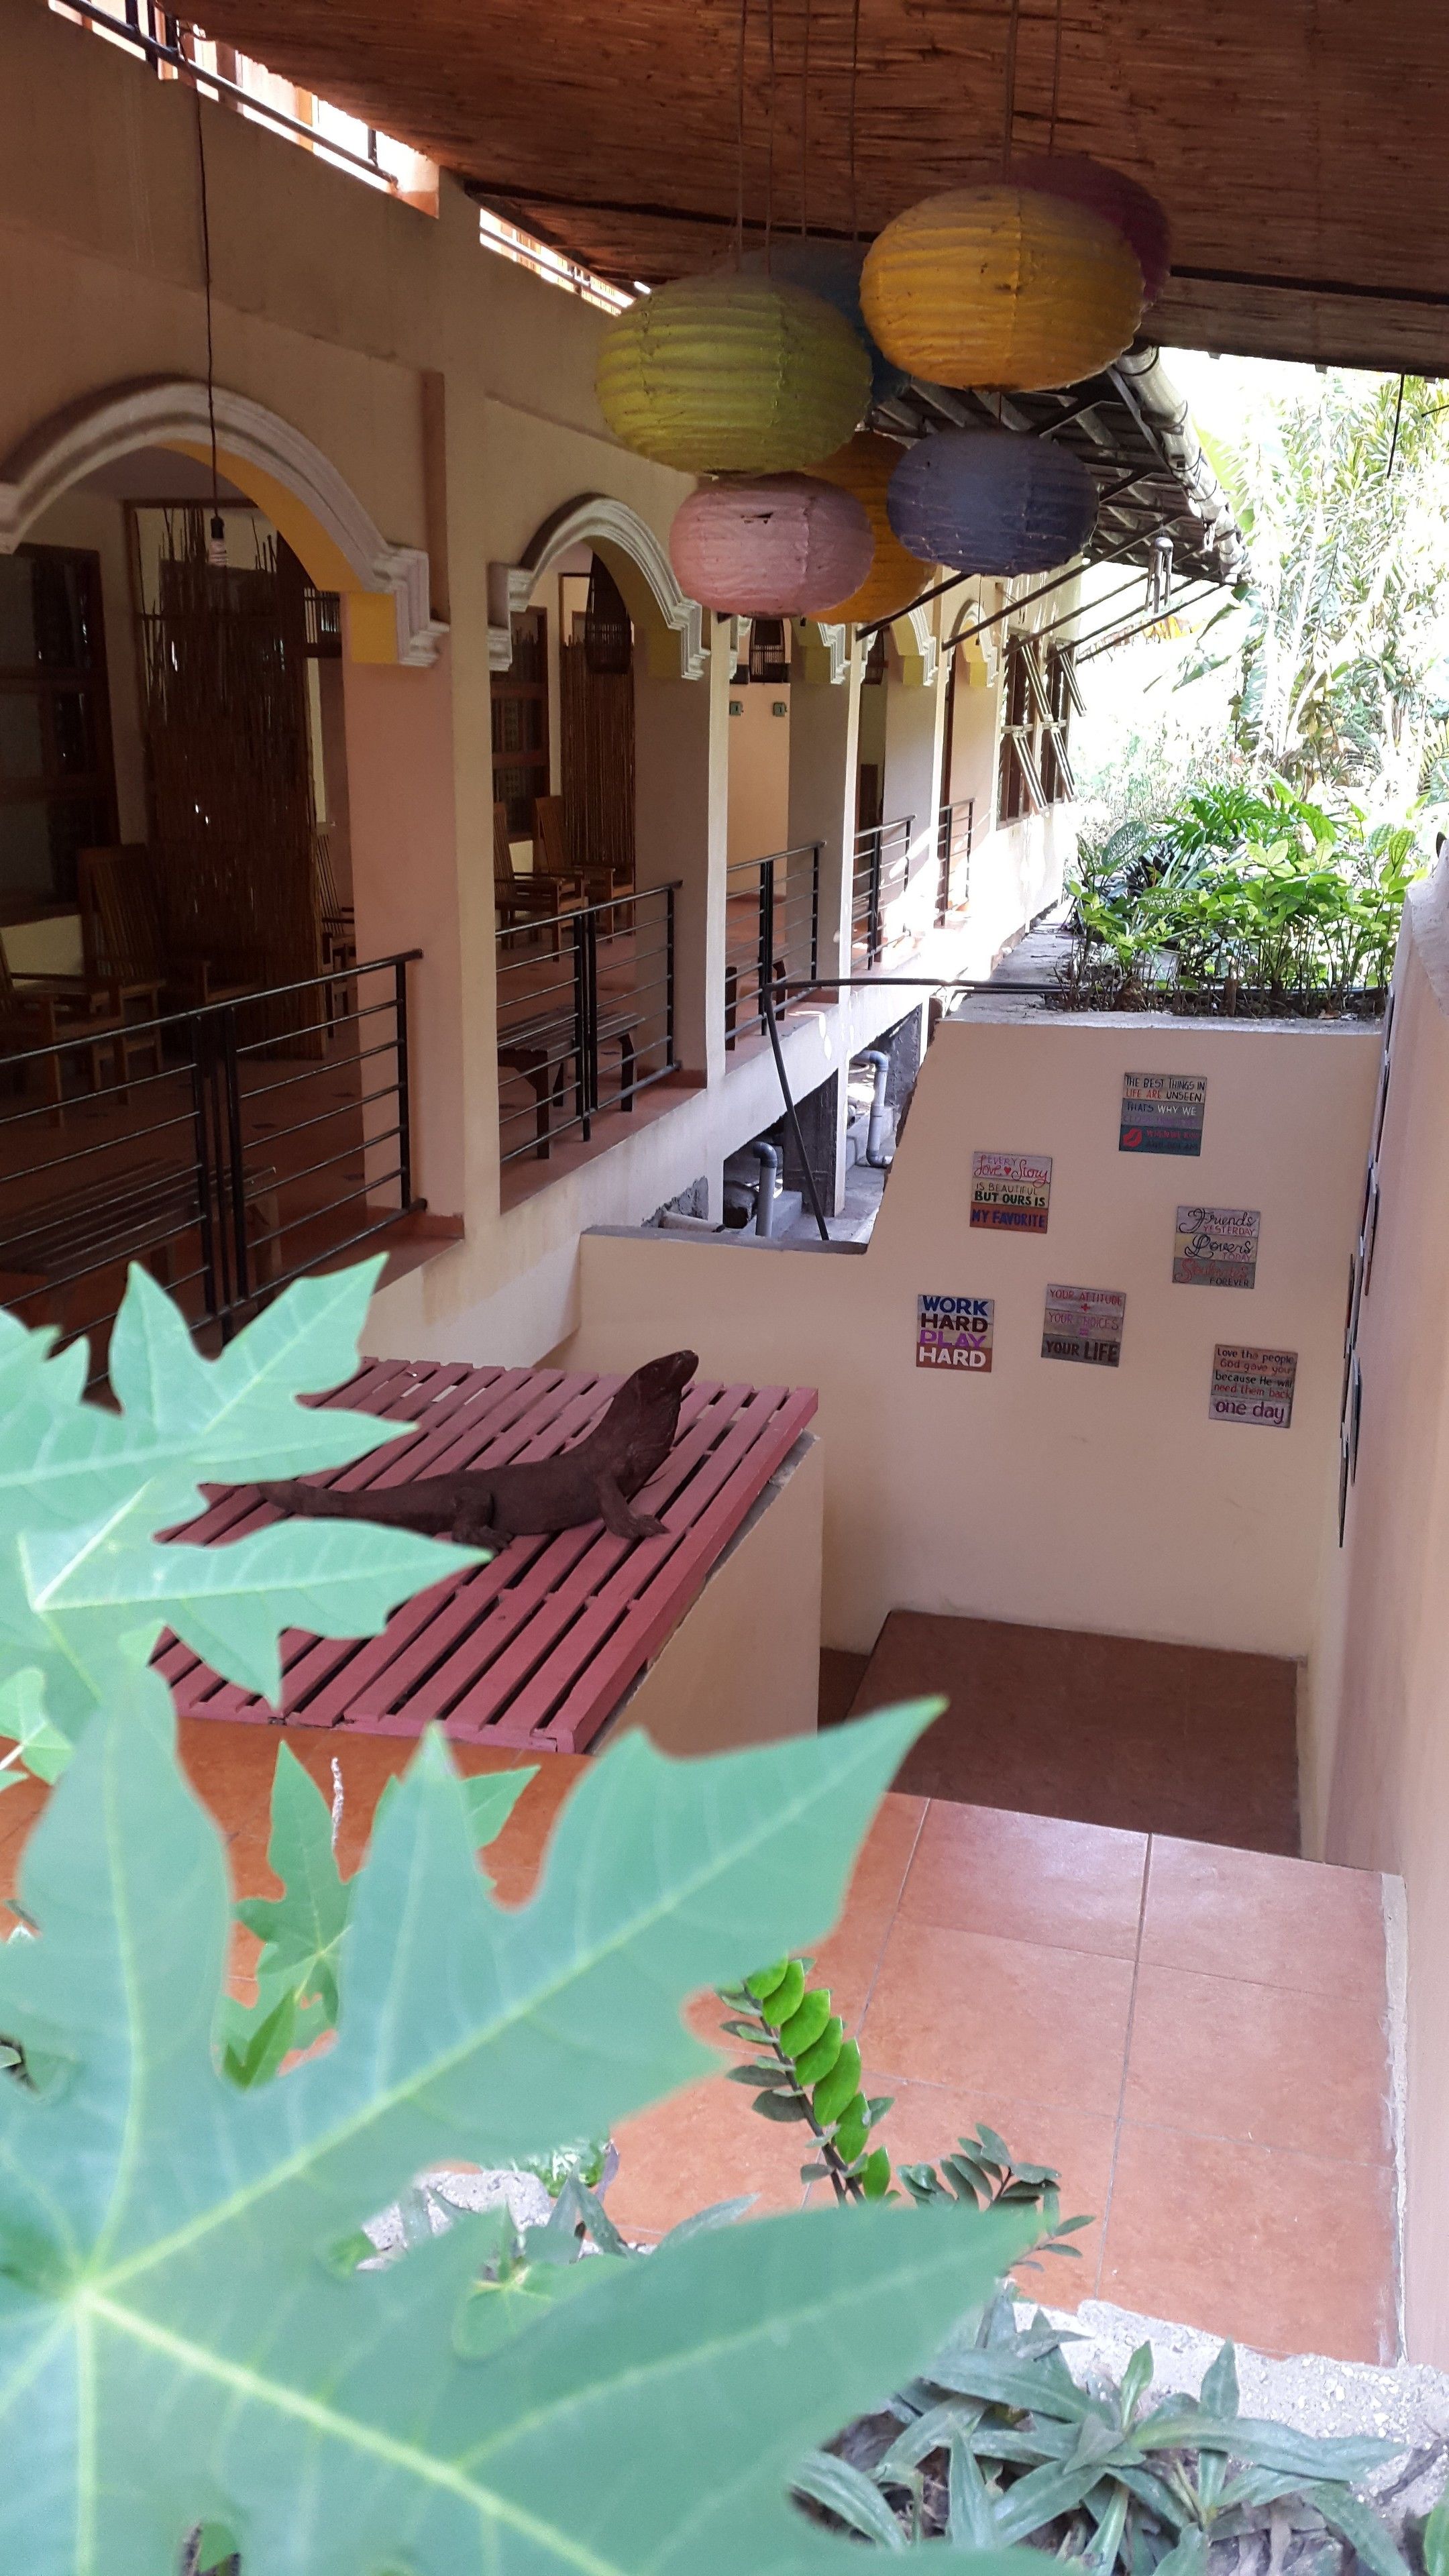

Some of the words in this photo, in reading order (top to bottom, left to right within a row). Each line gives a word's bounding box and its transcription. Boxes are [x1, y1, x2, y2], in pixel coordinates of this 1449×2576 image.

[1126, 1077, 1138, 1087] THE
[1143, 1078, 1164, 1088] BEST
[1169, 1077, 1195, 1090] THINGS
[1197, 1081, 1205, 1091] IN
[1126, 1088, 1140, 1098] LIFE
[1146, 1089, 1161, 1099] ARE
[1166, 1091, 1202, 1102] UNSEEN
[1157, 1104, 1179, 1114] WHY
[1182, 1106, 1196, 1116] WE
[987, 1157, 1018, 1166] EVERY
[974, 1155, 1002, 1177] Love
[1012, 1159, 1049, 1188] Story
[977, 1182, 985, 1191] IS
[989, 1183, 1038, 1195] BEAUTIFUL
[975, 1191, 999, 1202] BUT
[1002, 1194, 1032, 1205] OURS
[1034, 1197, 1045, 1207] IS
[972, 1209, 989, 1222] MY
[992, 1210, 1045, 1228] FAVORITE
[1179, 1208, 1256, 1233] Friends
[1203, 1225, 1255, 1235] YESTERDAY
[1185, 1234, 1253, 1258] Lovers
[1223, 1252, 1252, 1261] TODAY
[1210, 1277, 1249, 1286] FOREVER
[1050, 1289, 1074, 1300] YOUR
[1079, 1291, 1122, 1305] ATTITUDE
[922, 1295, 988, 1316] WORK
[921, 1313, 988, 1333] HARD
[1049, 1312, 1073, 1324] YOUR
[1079, 1316, 1119, 1330] HOICES
[920, 1330, 987, 1350] PLAY
[919, 1346, 986, 1367] HARD
[1046, 1340, 1080, 1356] YOUR
[1084, 1341, 1118, 1362] LIFE
[1242, 1350, 1258, 1360] the
[1263, 1354, 1294, 1366] people
[1220, 1358, 1240, 1368] God
[1244, 1363, 1268, 1373] gave
[1216, 1370, 1256, 1384] because
[1260, 1376, 1273, 1386] He
[1277, 1379, 1292, 1388] will
[1214, 1383, 1237, 1393] need
[1240, 1385, 1265, 1395] them
[1269, 1387, 1291, 1399] back
[1216, 1401, 1246, 1415] one
[1252, 1401, 1285, 1424] day
